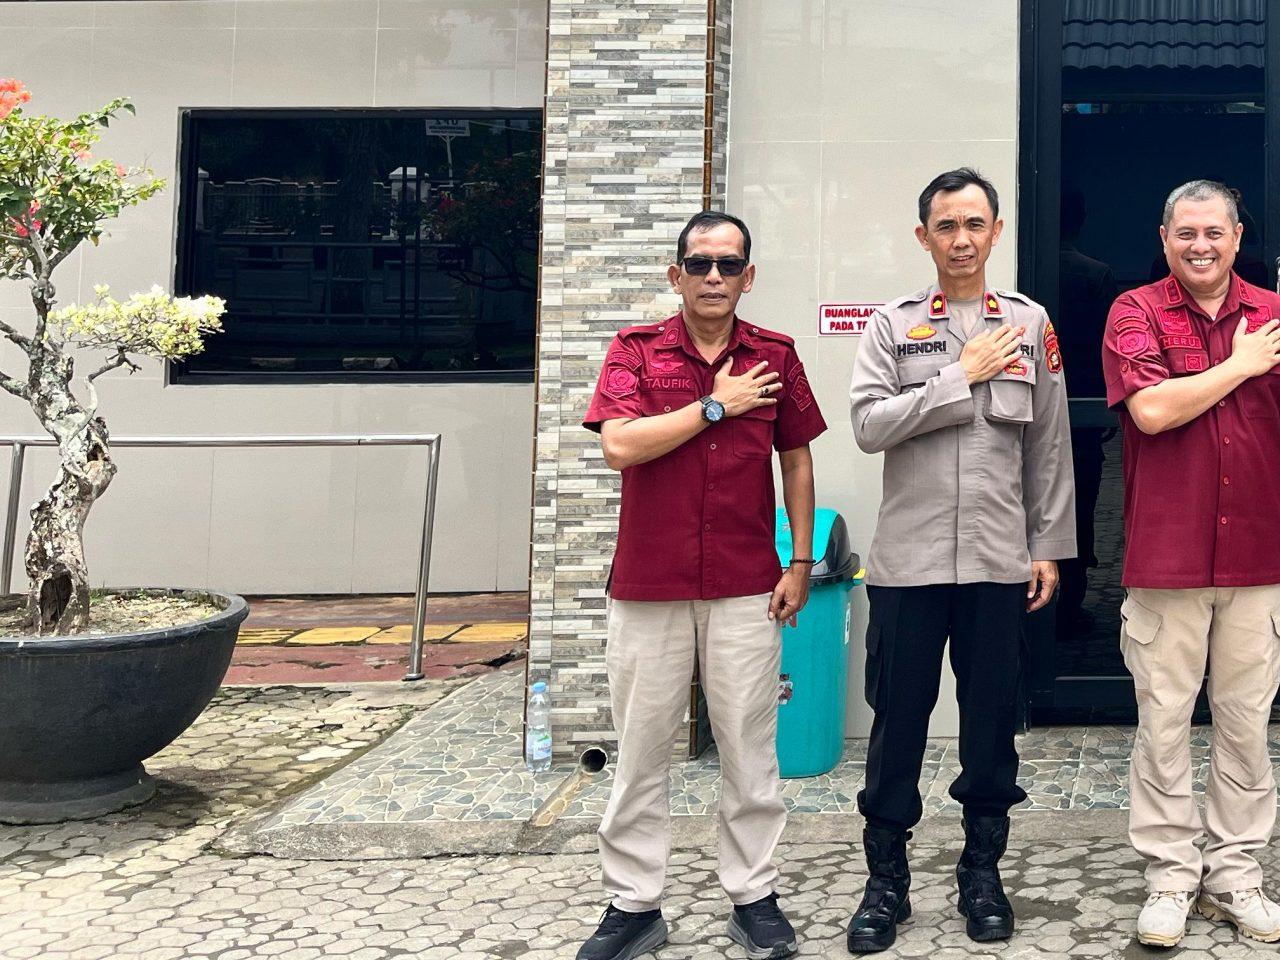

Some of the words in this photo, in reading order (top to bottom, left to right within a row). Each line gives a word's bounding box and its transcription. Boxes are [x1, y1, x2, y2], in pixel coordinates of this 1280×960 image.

[829, 321, 854, 331] PADA
[1162, 337, 1196, 347] HERU
[897, 340, 947, 357] HENDRI
[645, 377, 691, 389] TAUFIK
